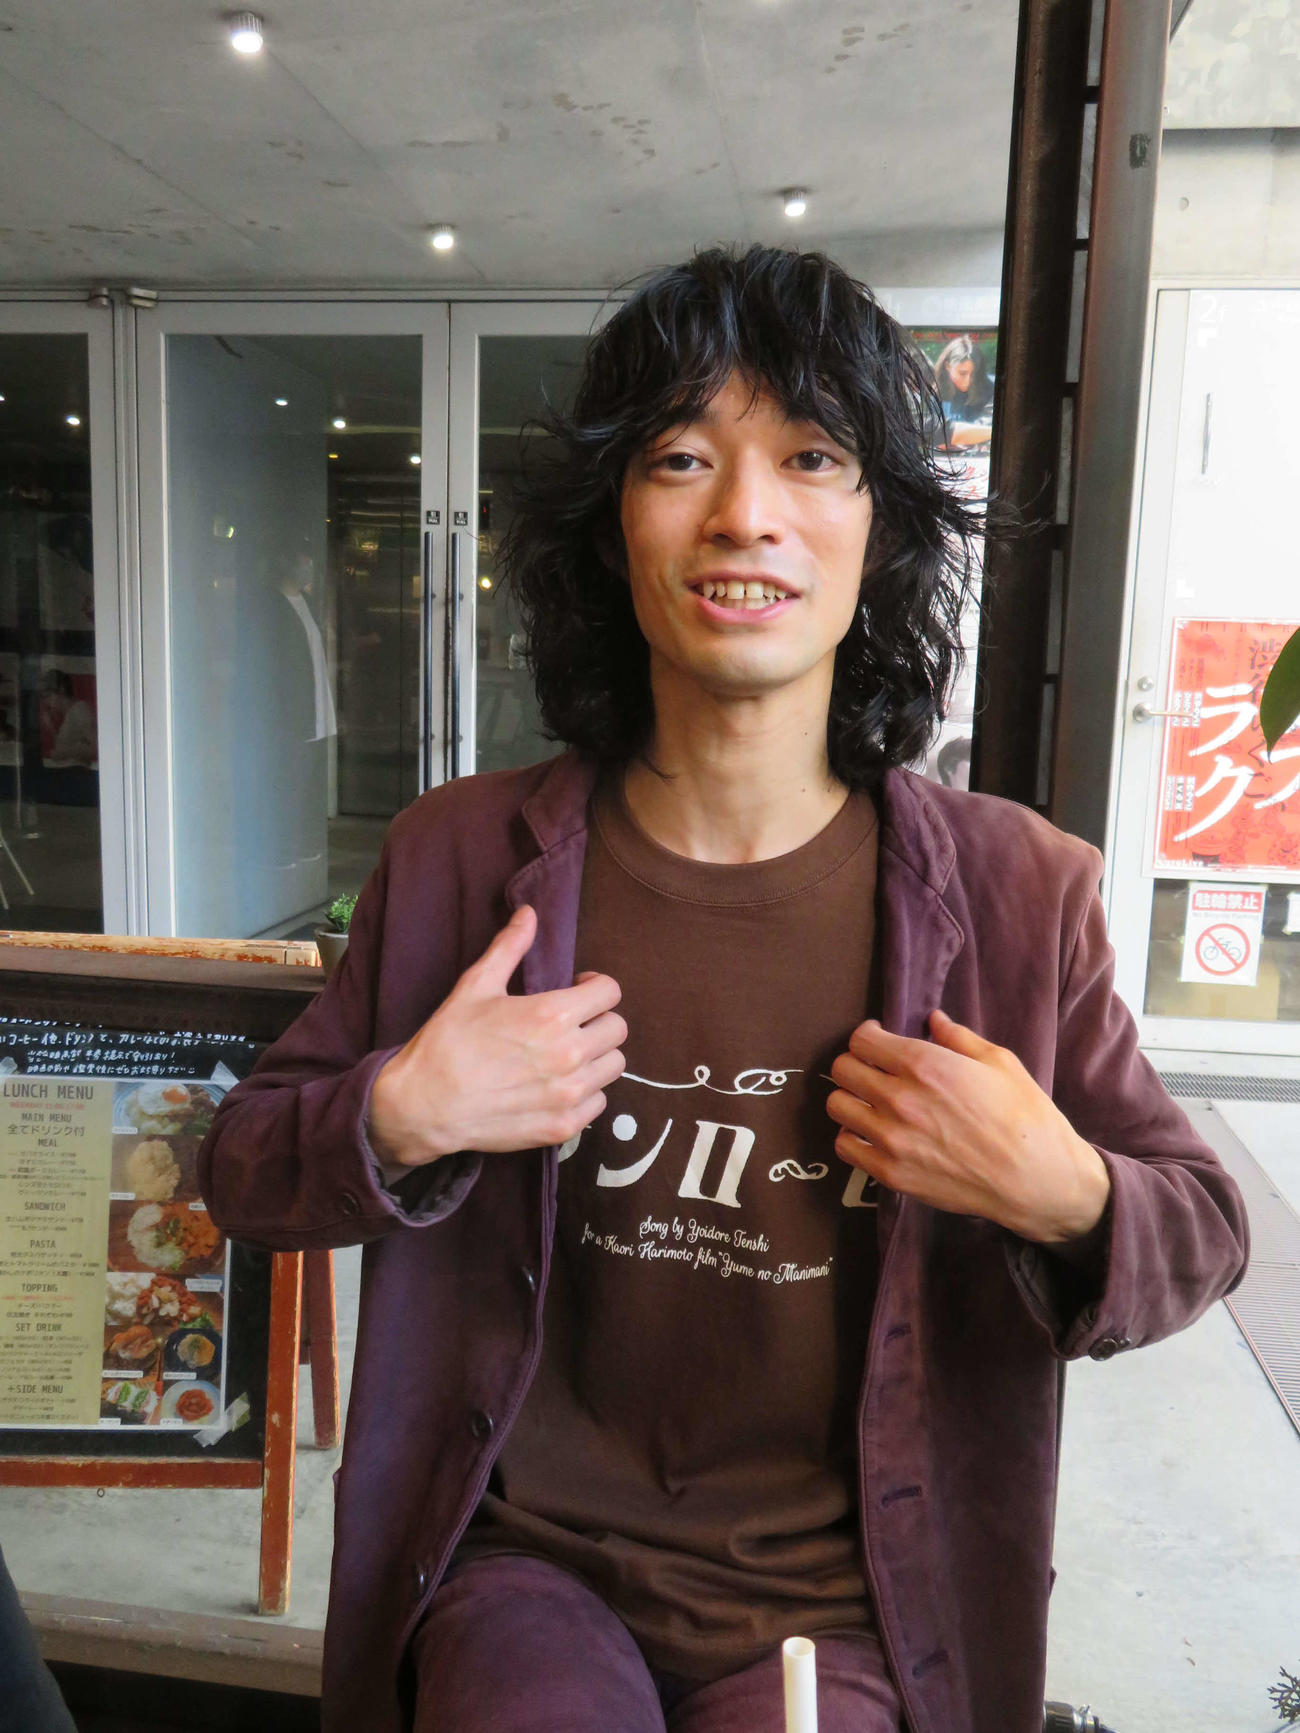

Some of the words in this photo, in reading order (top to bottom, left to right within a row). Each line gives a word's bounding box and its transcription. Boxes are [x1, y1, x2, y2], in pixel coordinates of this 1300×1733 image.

[3, 1083, 48, 1098] LUNCH
[57, 1085, 94, 1100] MENU
[21, 1113, 44, 1121] MAIN
[49, 1113, 72, 1122] MENU
[8, 1124, 85, 1136] 全てドリンク付
[38, 1138, 57, 1147] MEAL
[24, 1201, 66, 1211] SANDWICH
[640, 1216, 669, 1239] Song
[672, 1216, 684, 1240] by
[687, 1218, 731, 1243] Yoidore
[733, 1229, 770, 1252] Tenshi
[30, 1240, 56, 1248] PASTA
[581, 1222, 594, 1244] for
[595, 1236, 602, 1246] a
[604, 1235, 634, 1256] Kaori
[638, 1240, 694, 1260] Harimoto
[693, 1247, 717, 1270] film
[758, 1269, 772, 1280] no
[22, 1283, 58, 1292] TOPPING
[15, 1323, 30, 1332] SET
[36, 1323, 62, 1332] DRINK
[42, 1384, 64, 1393] MENU
